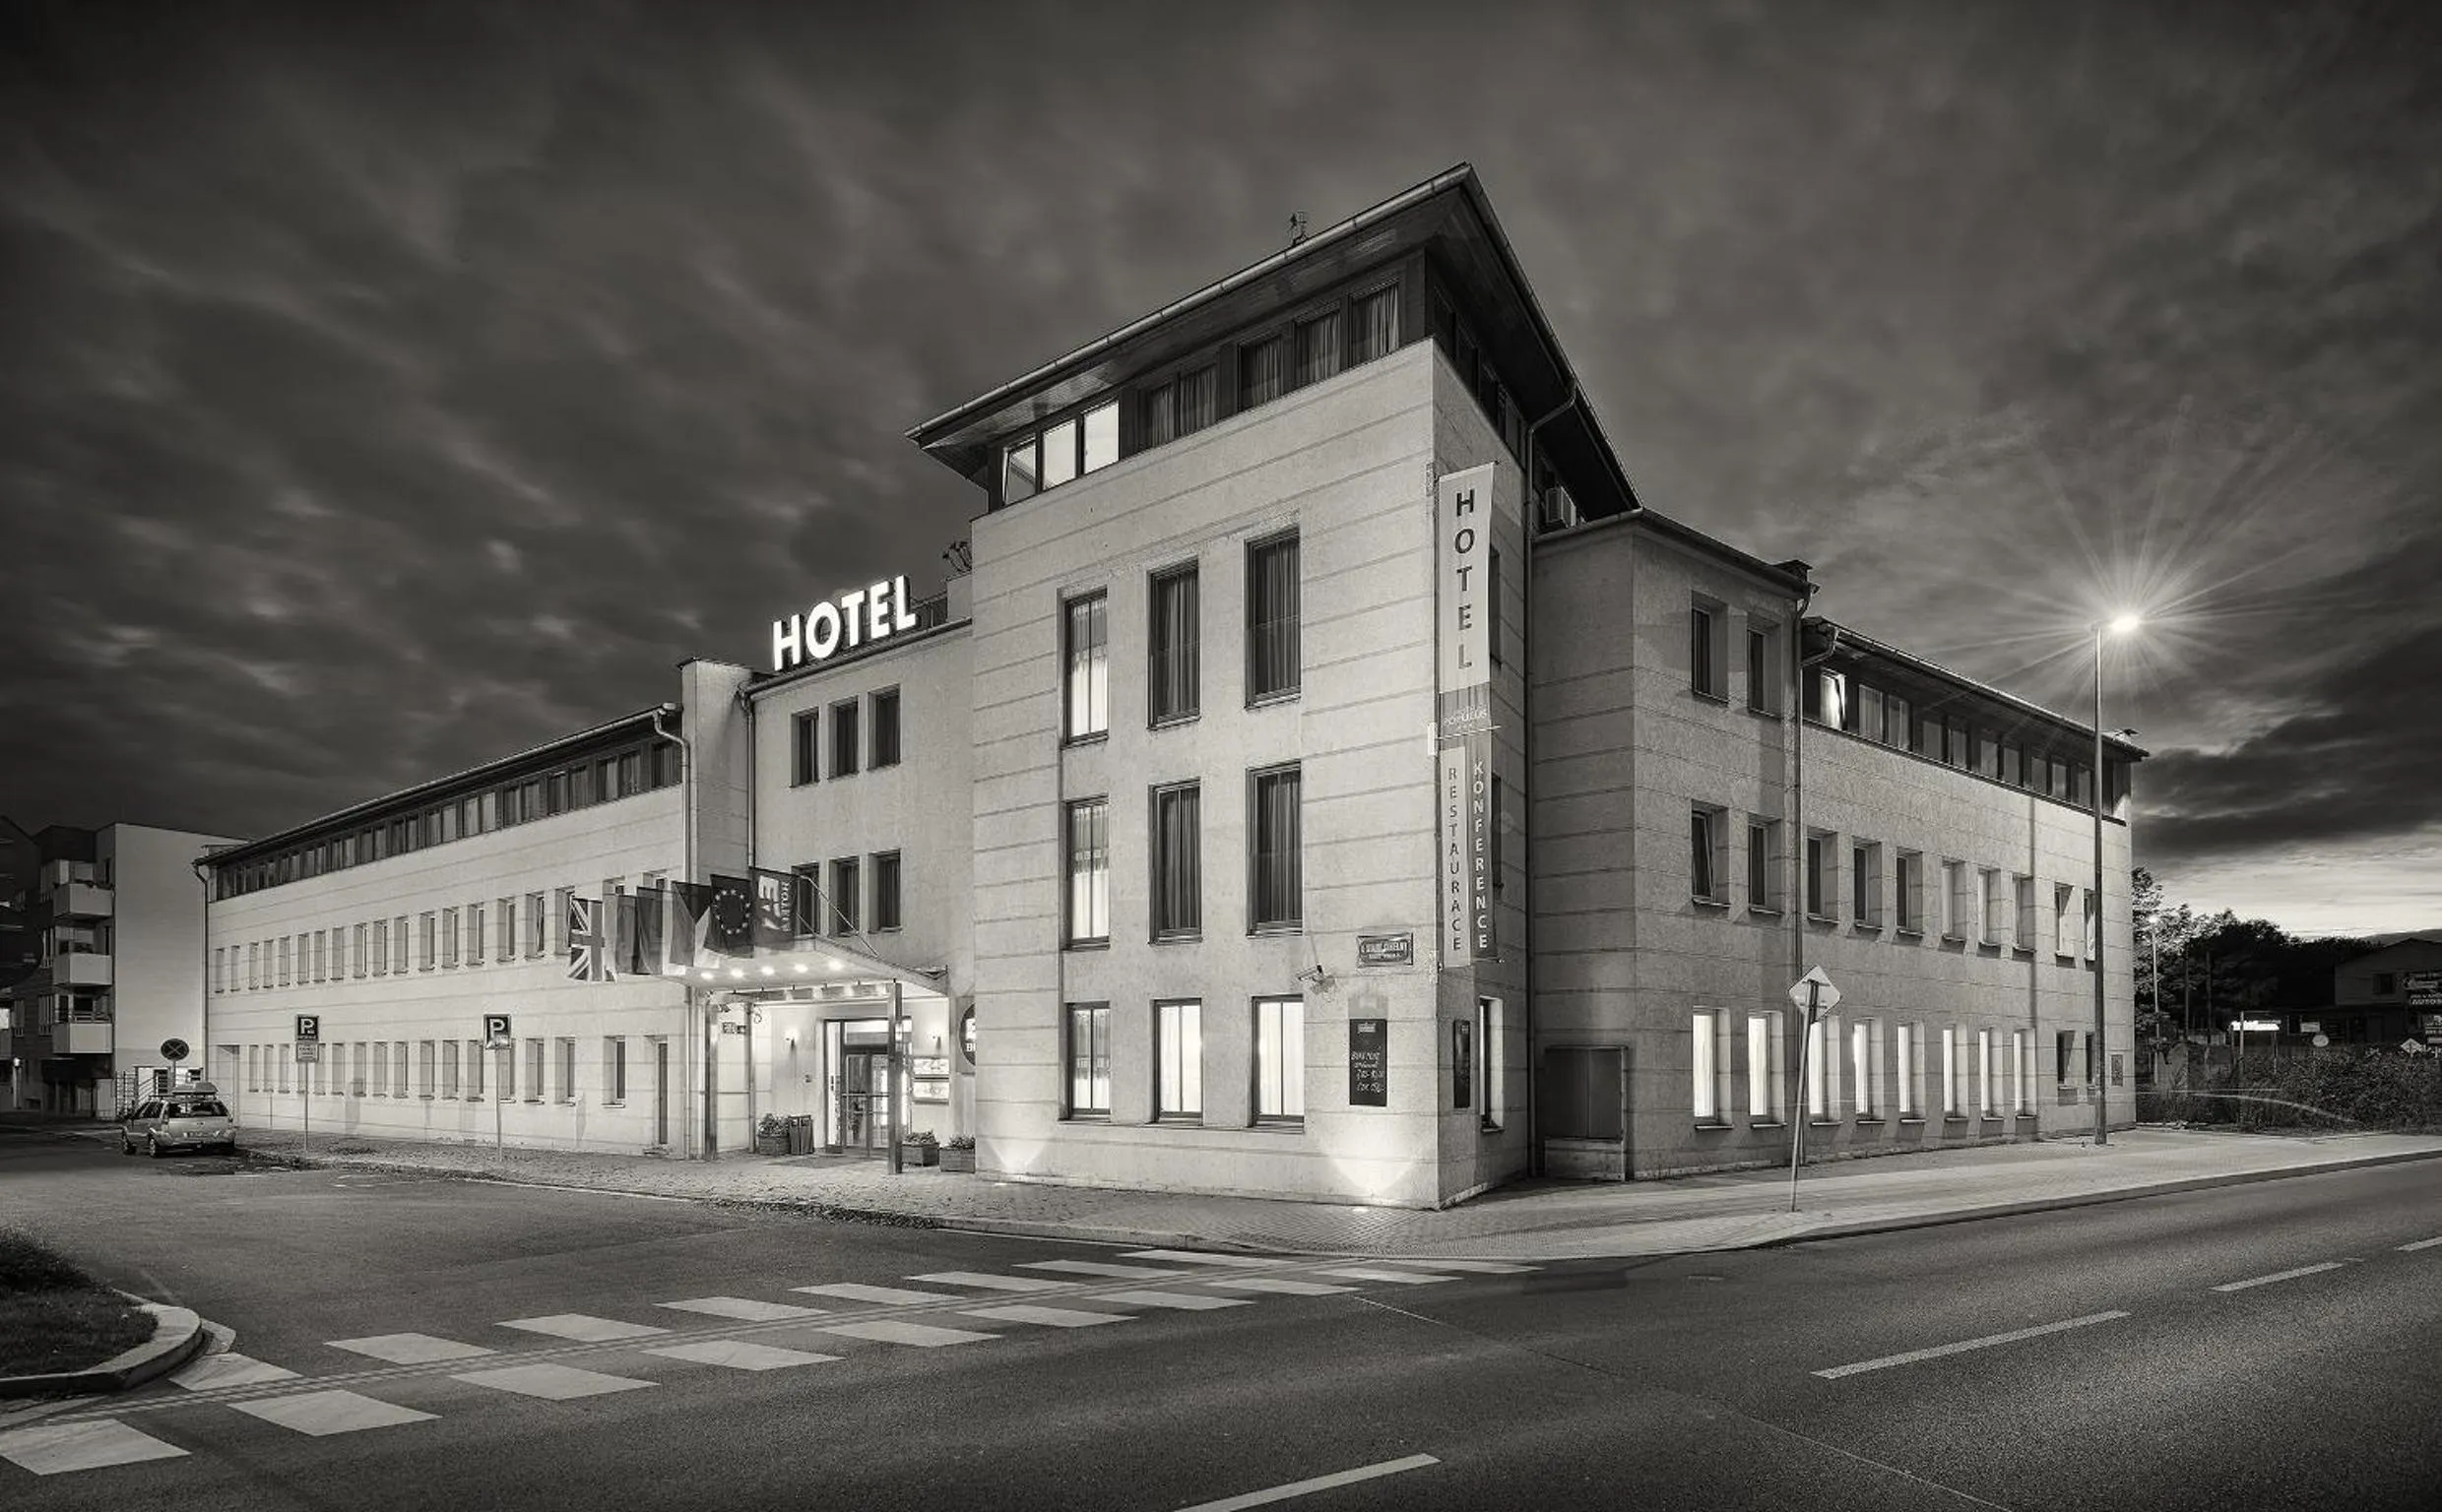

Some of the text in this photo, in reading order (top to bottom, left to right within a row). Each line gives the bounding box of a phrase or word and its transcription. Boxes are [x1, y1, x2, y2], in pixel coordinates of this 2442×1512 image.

[772, 574, 918, 672] HOTEL
[1454, 488, 1476, 670] HOTEL
[1448, 767, 1462, 951] RESTAURACE
[1472, 761, 1488, 949] KONFERENCE
[300, 1018, 315, 1035] P
[489, 1018, 505, 1040] P
